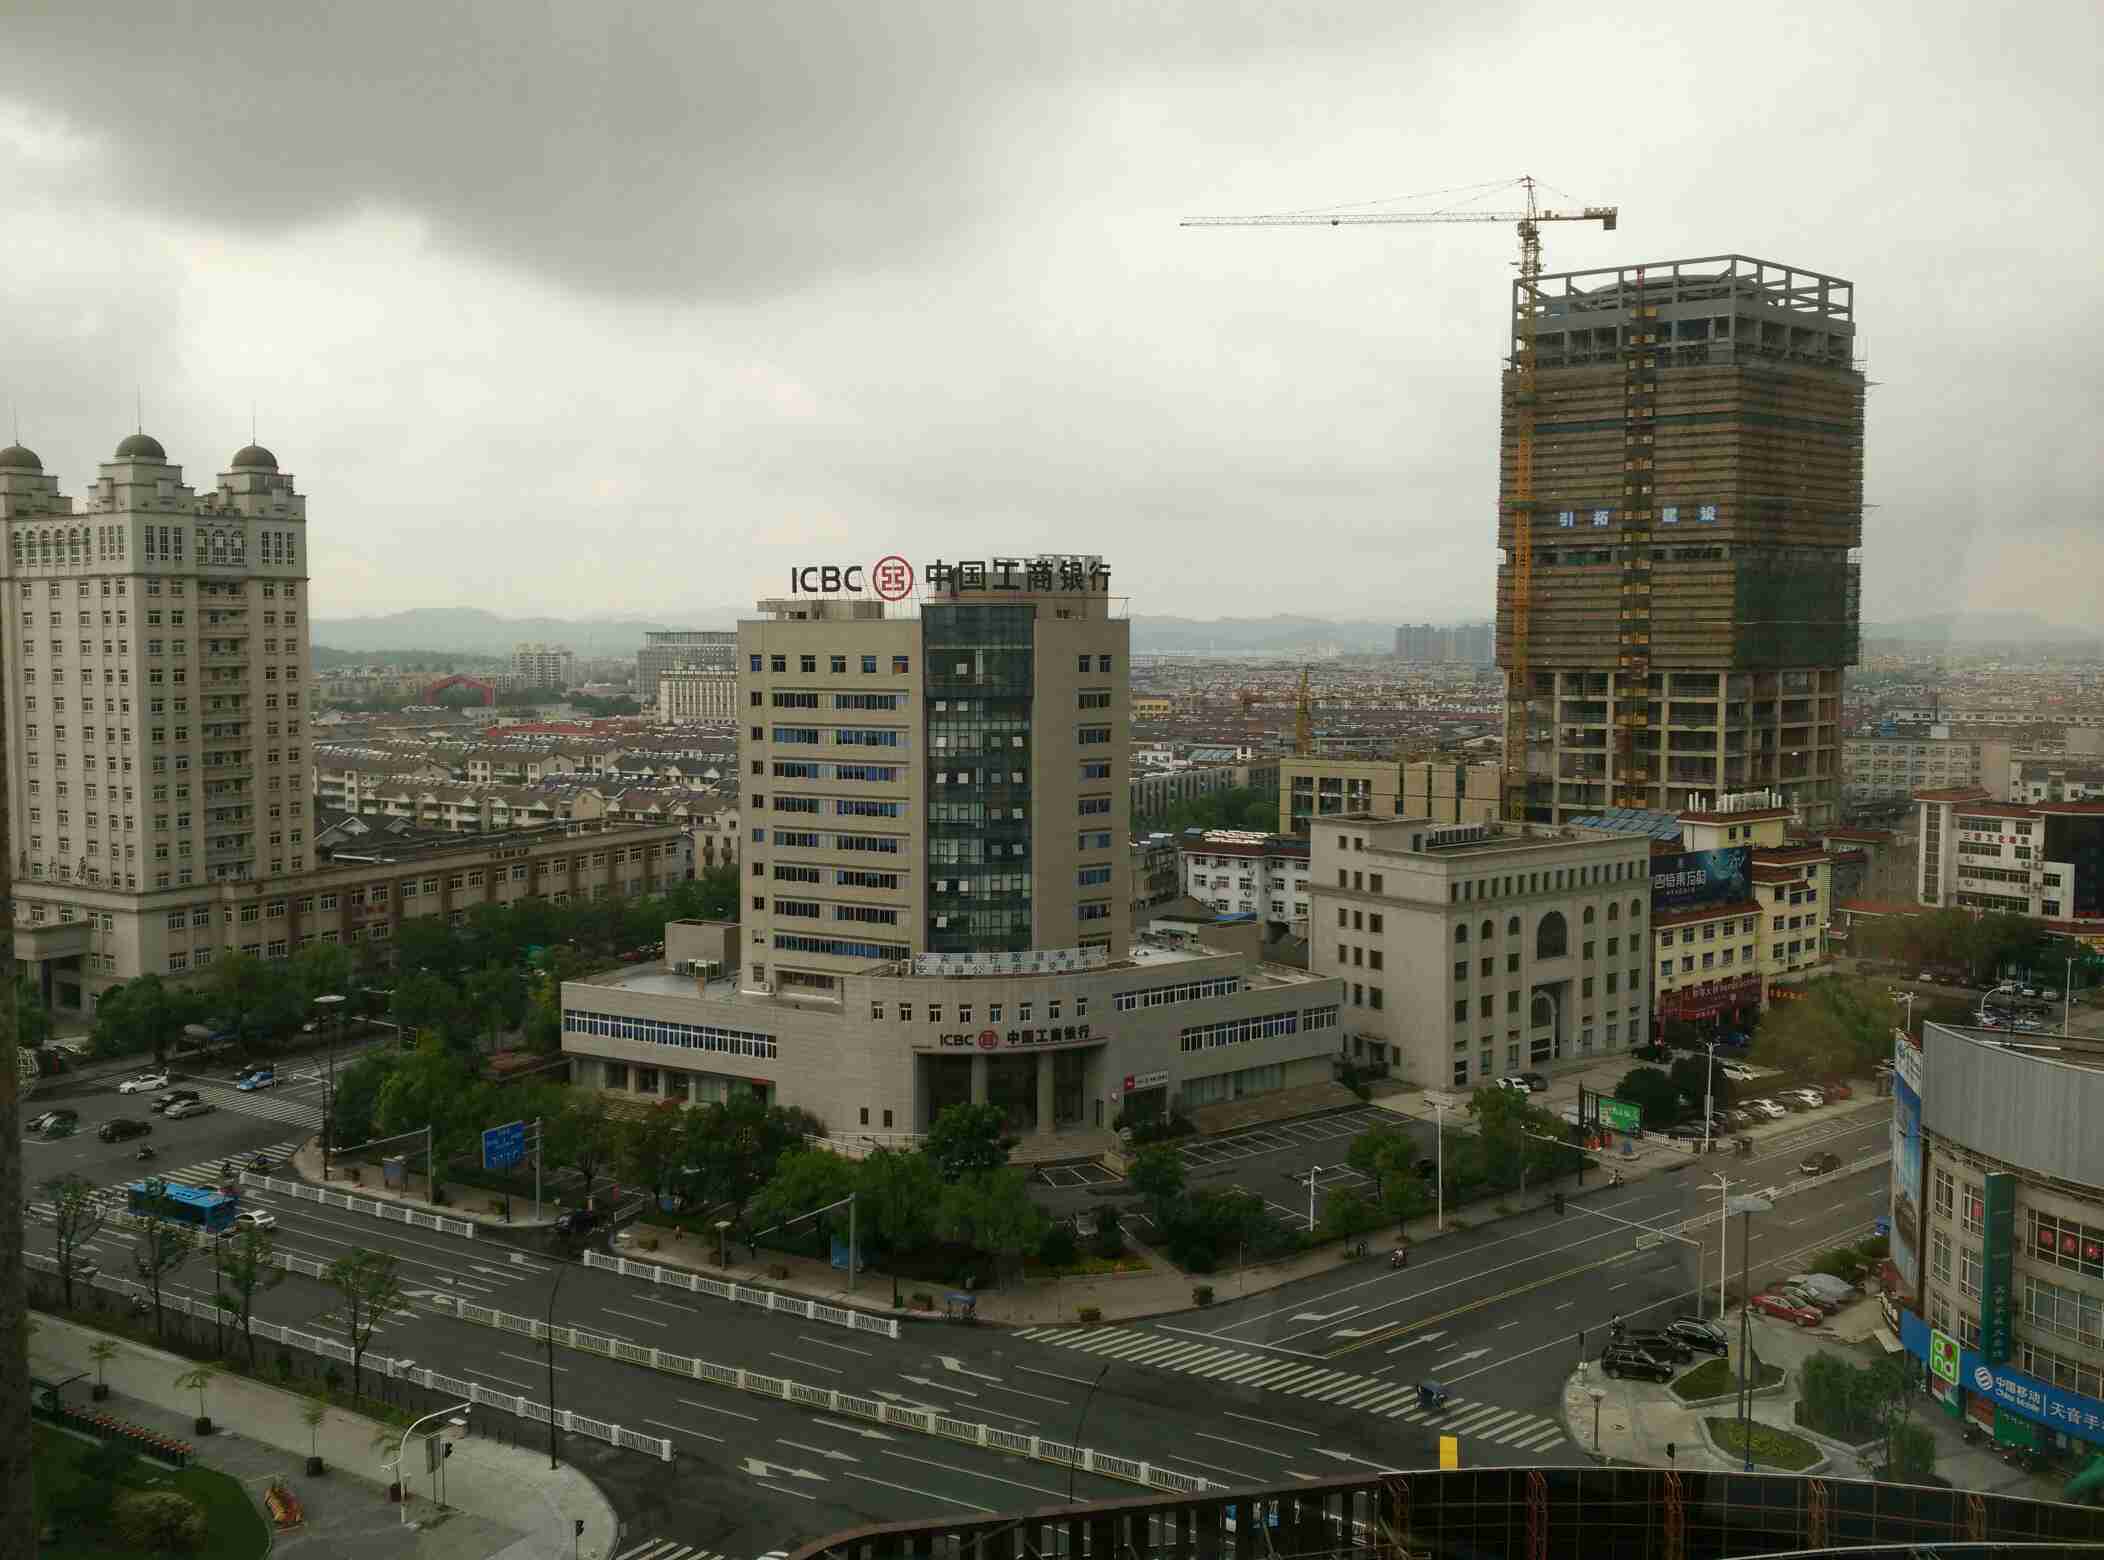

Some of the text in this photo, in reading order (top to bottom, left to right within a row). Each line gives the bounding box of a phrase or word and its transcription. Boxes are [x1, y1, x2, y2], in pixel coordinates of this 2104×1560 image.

[791, 566, 863, 593] ICBC
[925, 558, 1111, 593] 中国工商银行
[940, 1034, 975, 1047] ICBC
